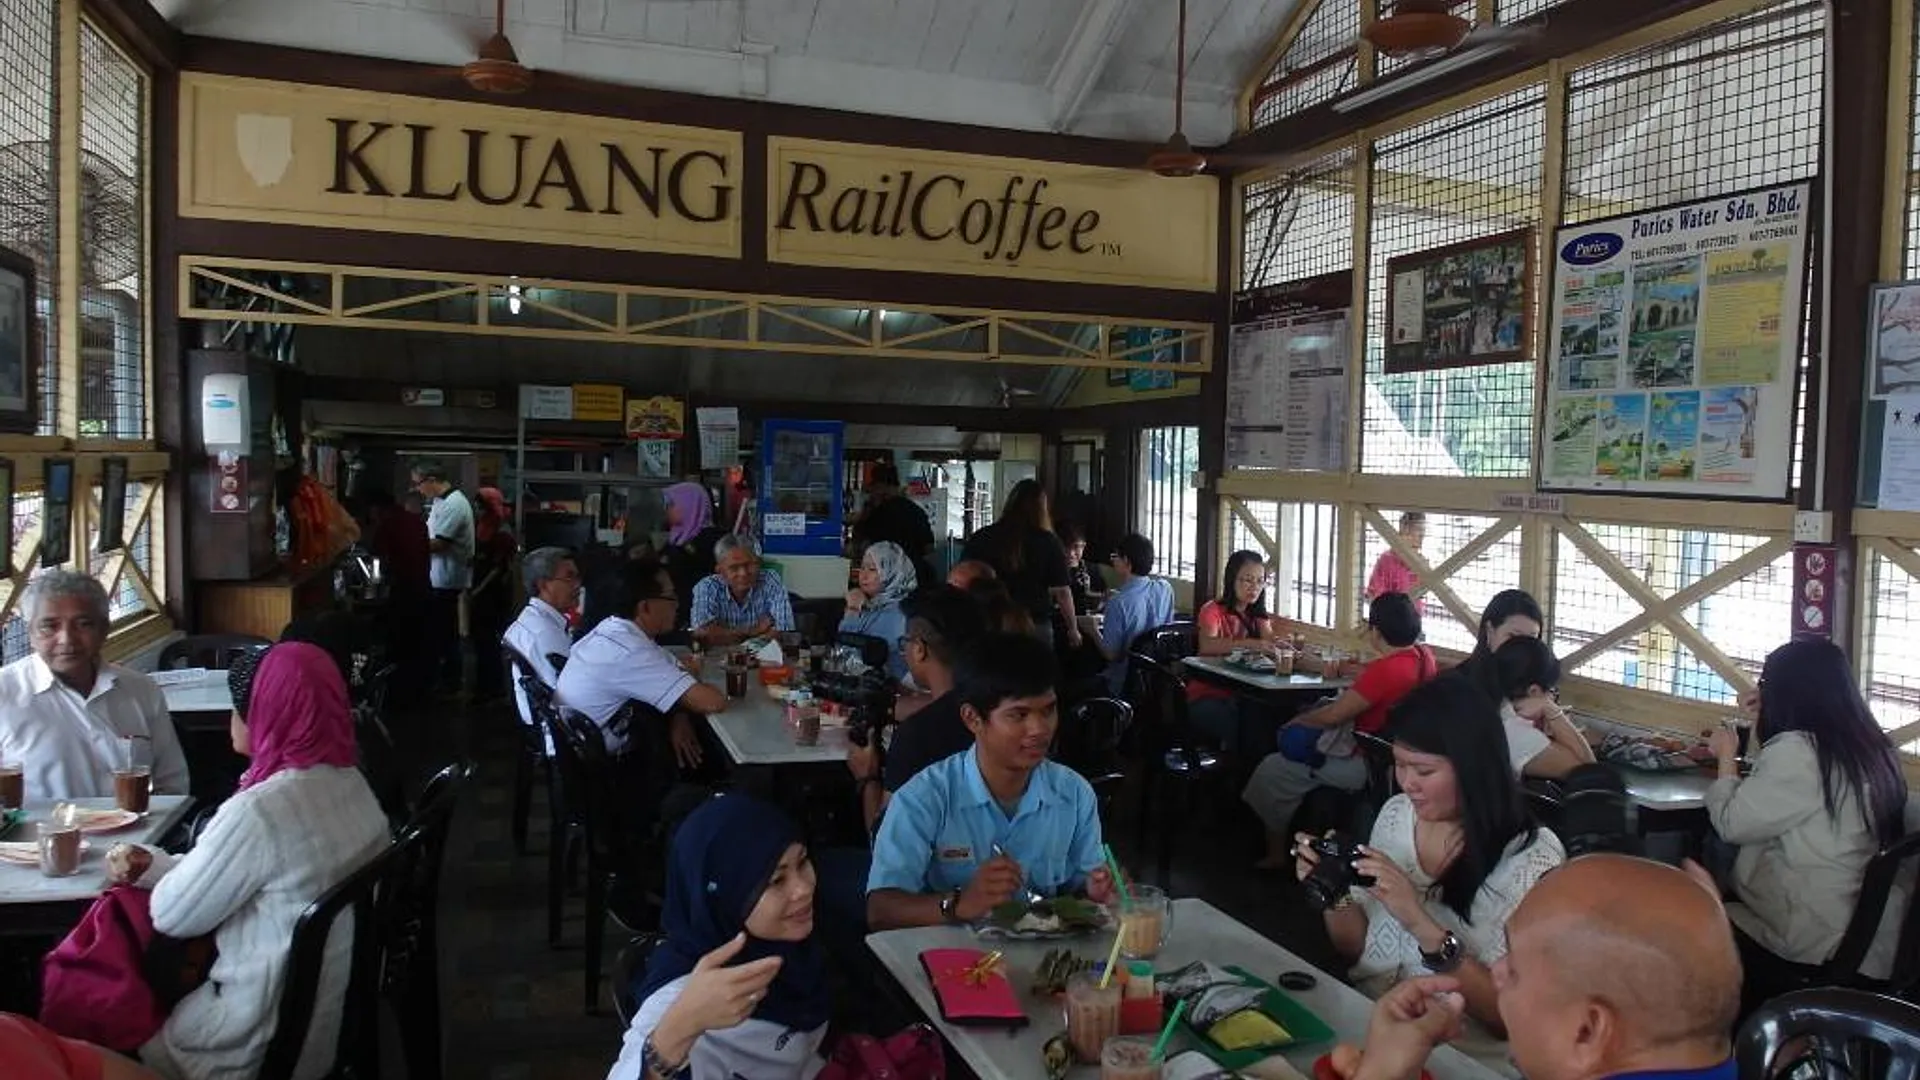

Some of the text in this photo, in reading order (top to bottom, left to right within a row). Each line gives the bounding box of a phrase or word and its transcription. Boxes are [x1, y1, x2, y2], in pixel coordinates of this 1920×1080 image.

[325, 116, 734, 223] KLUANG
[774, 160, 1100, 260] RailCoffee
[1679, 207, 1719, 230] Water
[1725, 197, 1759, 222] Sdn.
[1766, 190, 1801, 215] Bhd.
